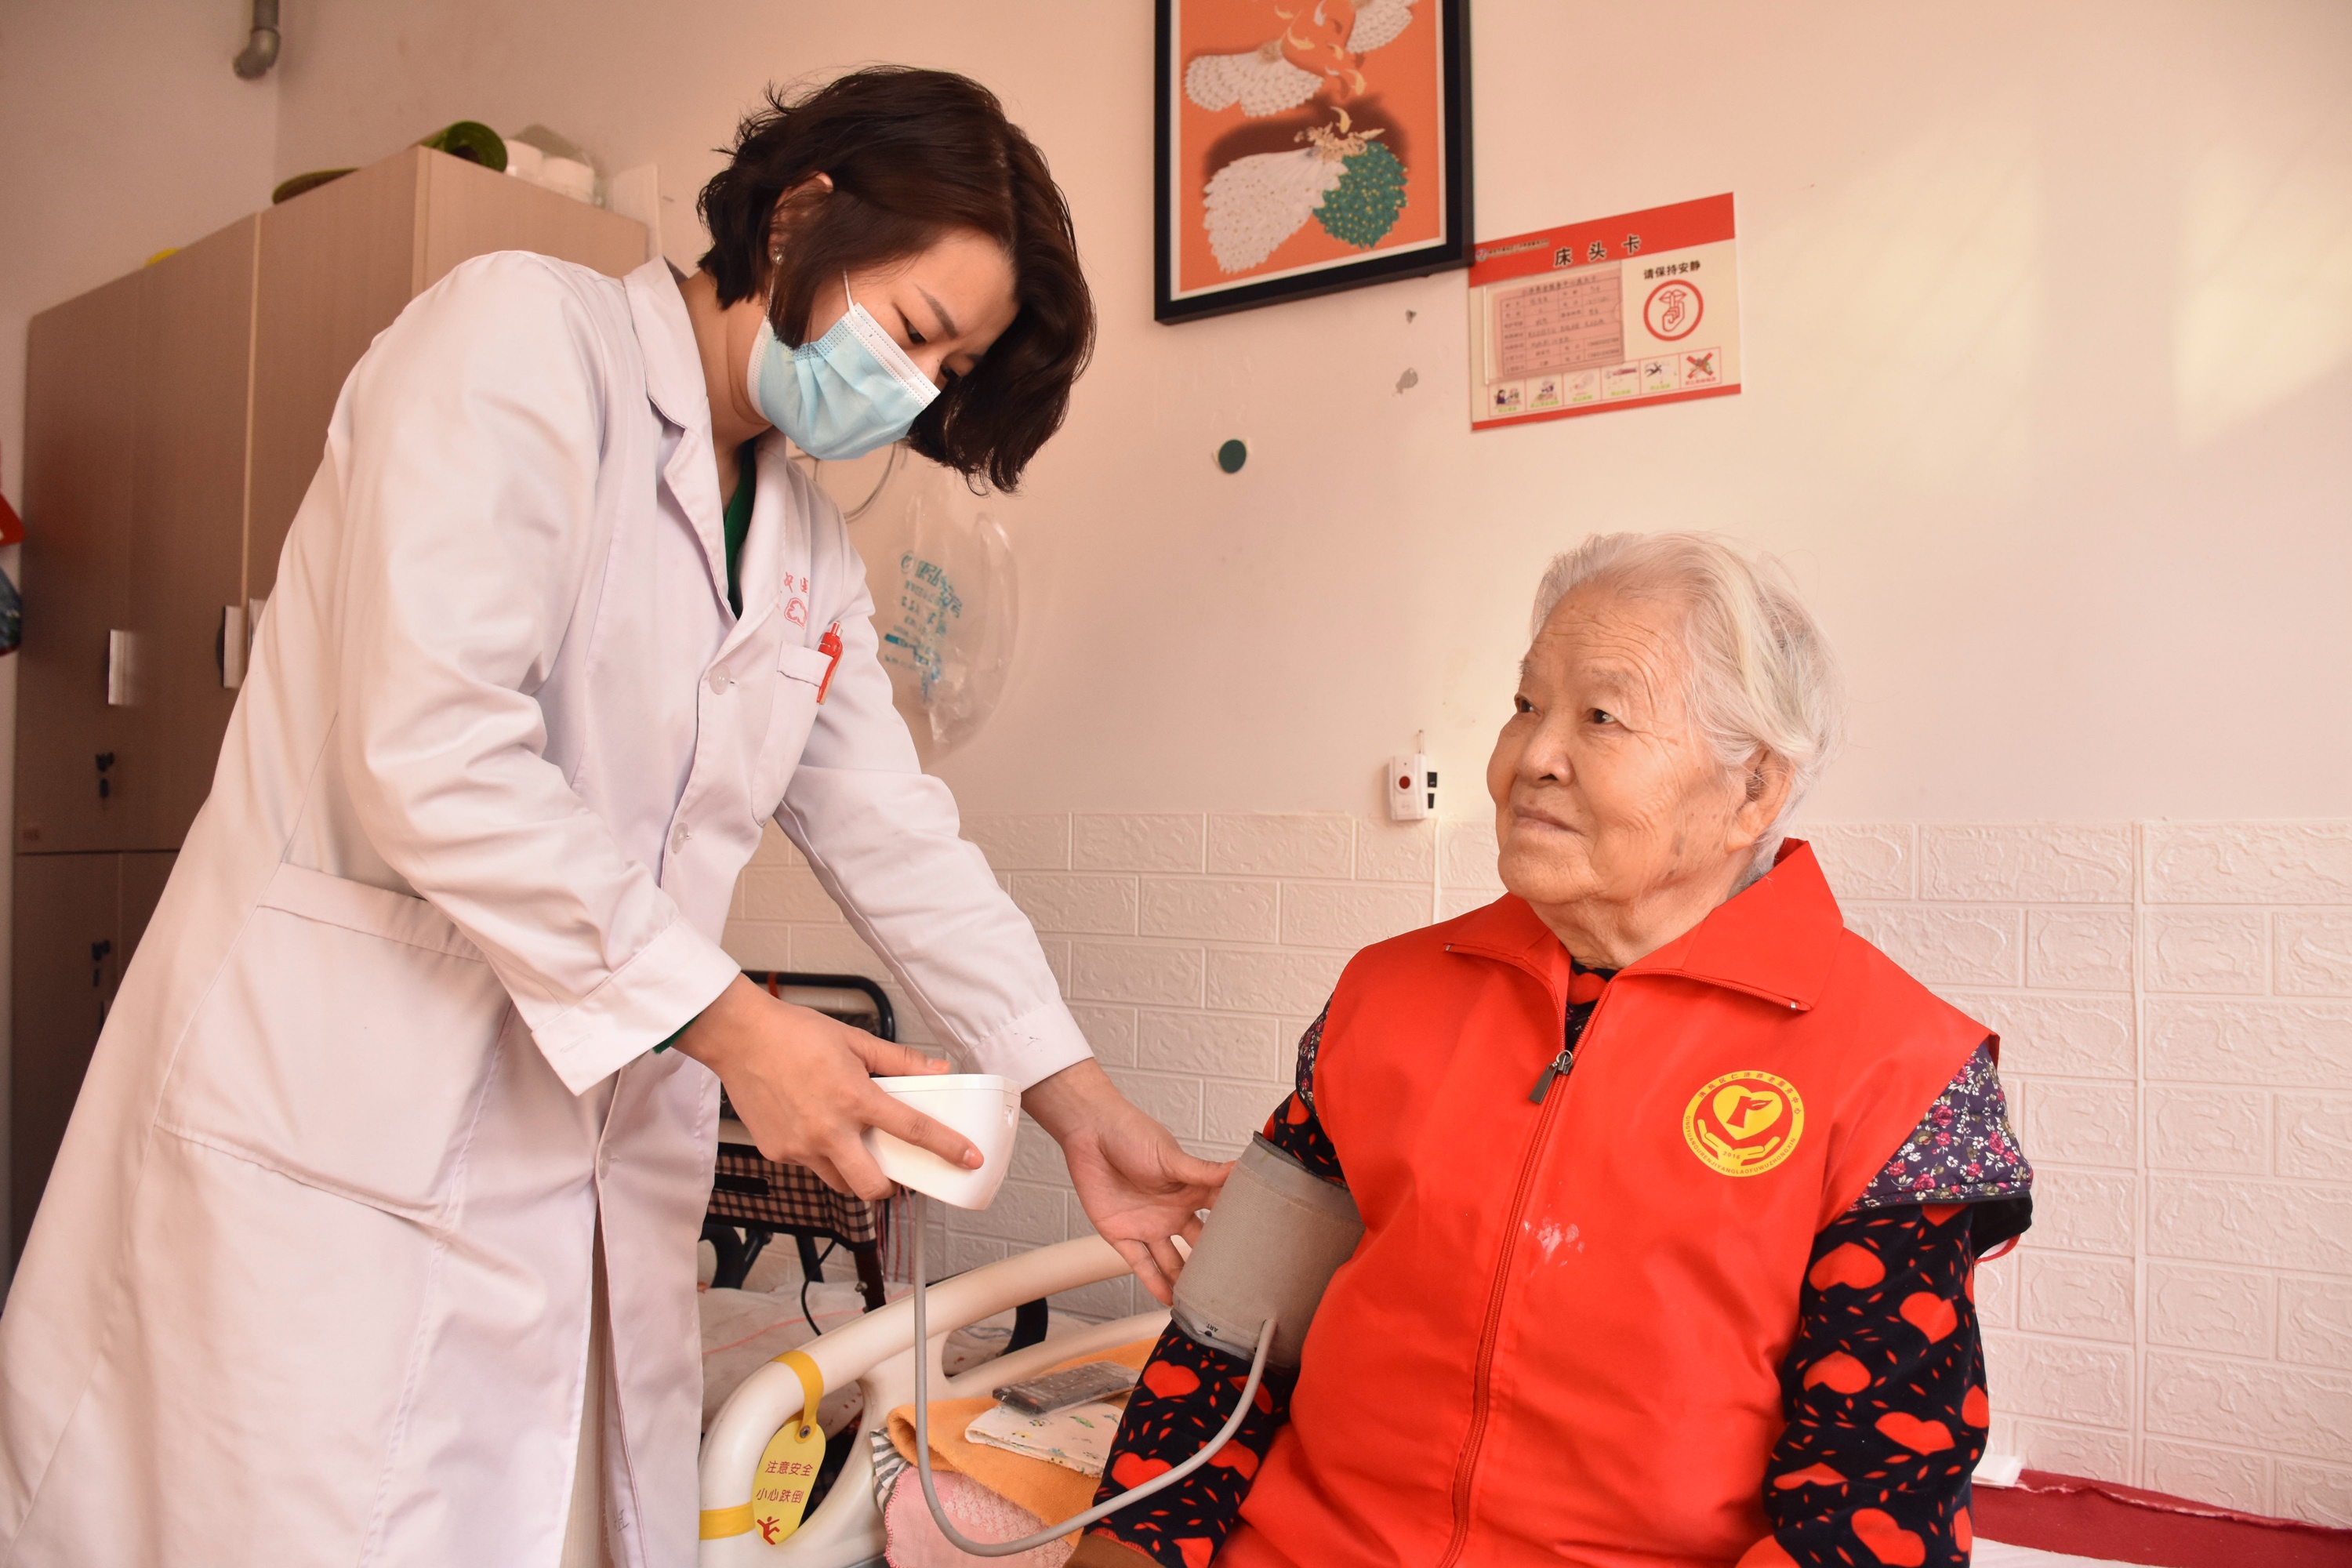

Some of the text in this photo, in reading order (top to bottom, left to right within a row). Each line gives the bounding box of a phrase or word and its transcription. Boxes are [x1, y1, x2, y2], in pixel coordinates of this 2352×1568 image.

[1555, 235, 1641, 267] 床头卡
[1643, 260, 1700, 280] 请保持安静
[1722, 1150, 1740, 1160] 2016
[765, 1461, 813, 1476] 注意安全
[756, 1488, 804, 1504] 小心跌倒
